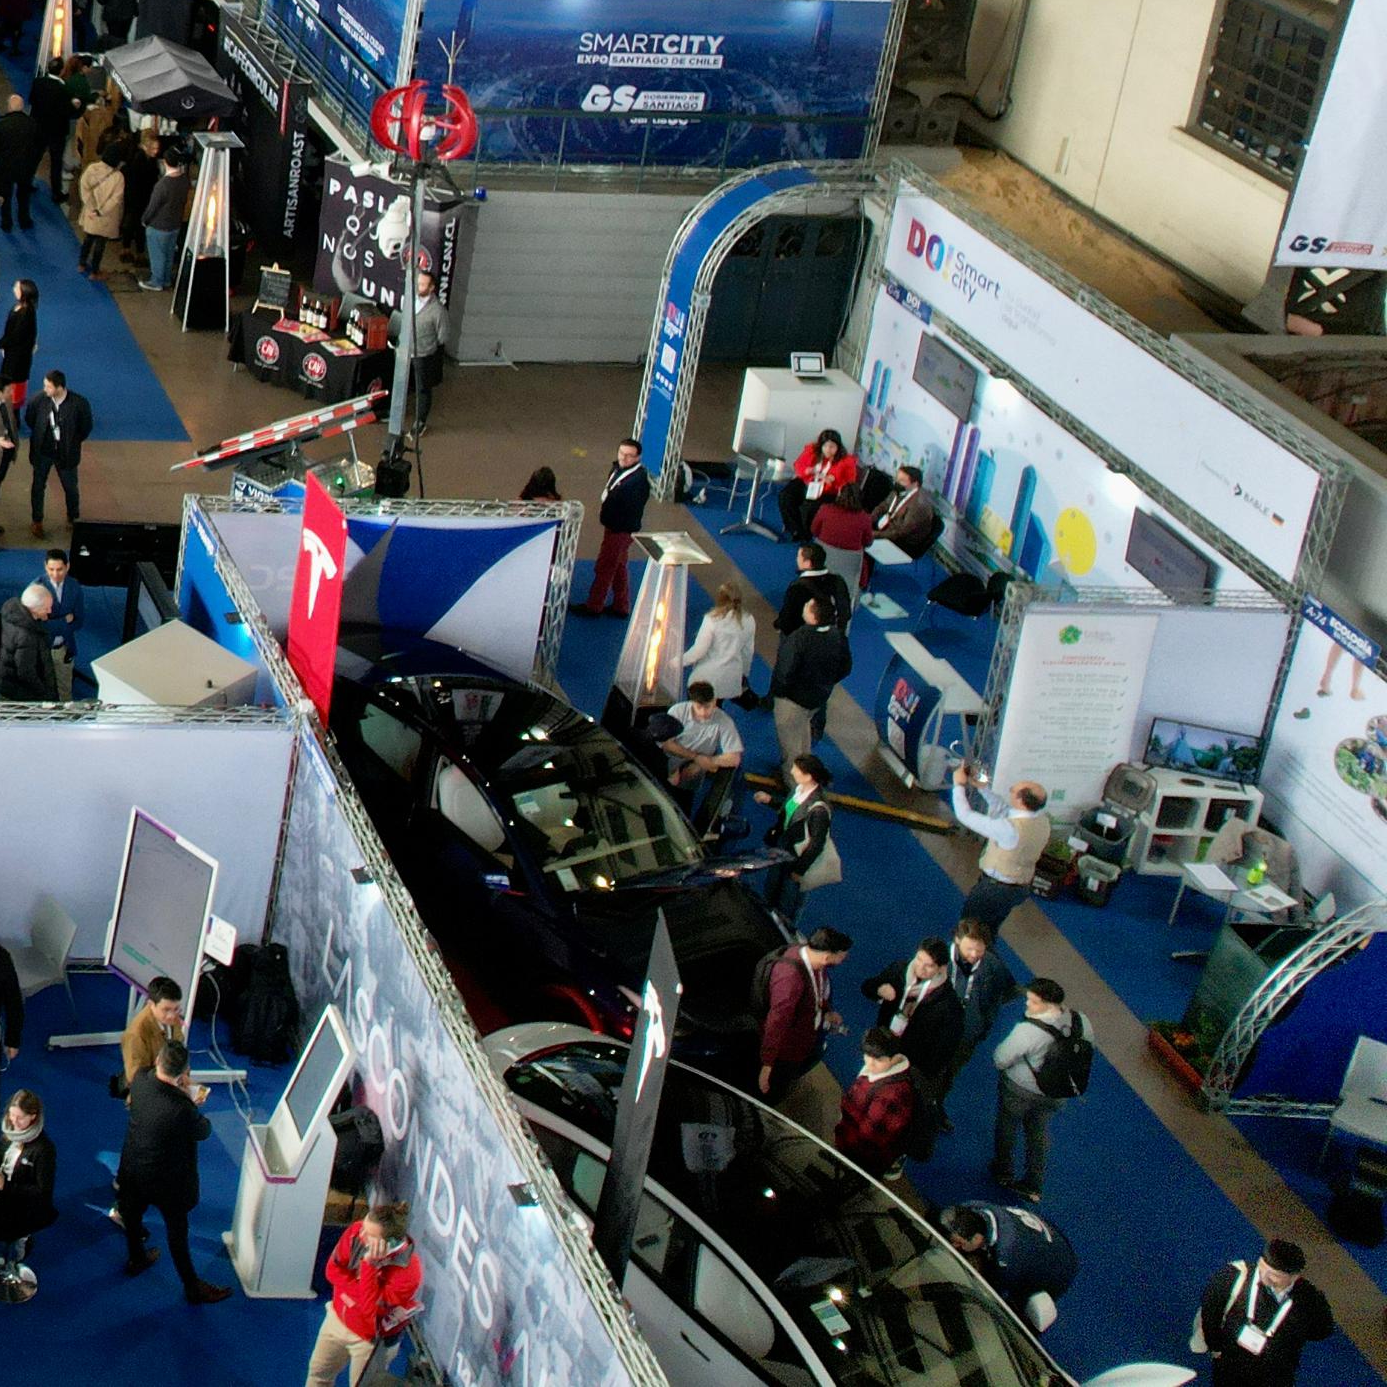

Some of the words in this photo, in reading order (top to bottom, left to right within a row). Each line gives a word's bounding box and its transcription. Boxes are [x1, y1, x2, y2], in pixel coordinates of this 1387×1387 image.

[579, 32, 725, 55] SMARTCITY
[576, 54, 608, 65] EXPO
[610, 55, 669, 67] SANTIAGO
[671, 56, 686, 67] DE
[688, 56, 721, 68] CHILE
[581, 84, 640, 112] GS
[642, 101, 699, 111] SANTIAGO
[283, 130, 306, 239] ARTISANROAST
[1289, 234, 1328, 254] GS
[951, 272, 977, 303] city
[954, 251, 1001, 299] Smart
[367, 1023, 501, 1330] CONDES
